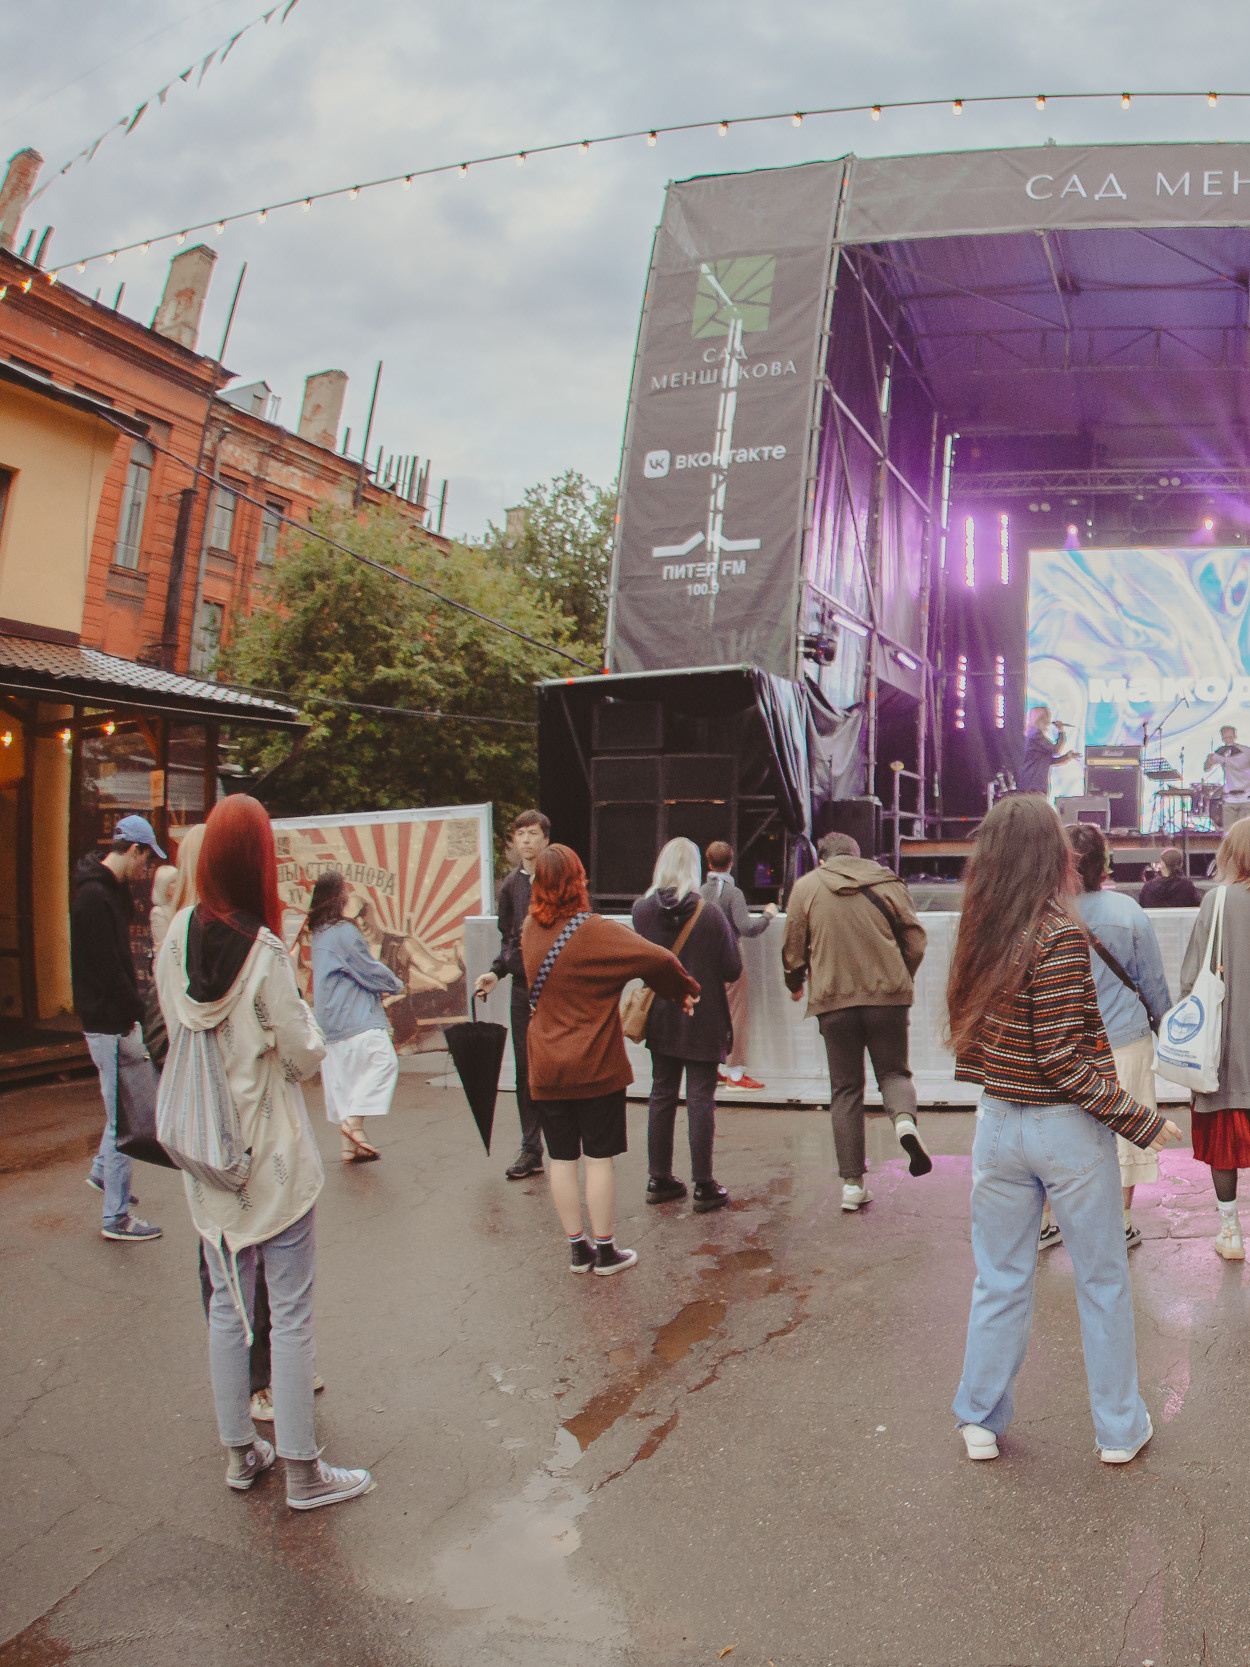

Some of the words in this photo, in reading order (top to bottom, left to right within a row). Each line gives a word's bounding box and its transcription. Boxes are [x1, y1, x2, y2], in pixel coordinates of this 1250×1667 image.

[1025, 173, 1128, 201] САД
[651, 360, 797, 390] МЕНШКОВА
[662, 562, 719, 581] ПИТЕР
[722, 559, 747, 576] FM
[687, 582, 720, 596] 100.9
